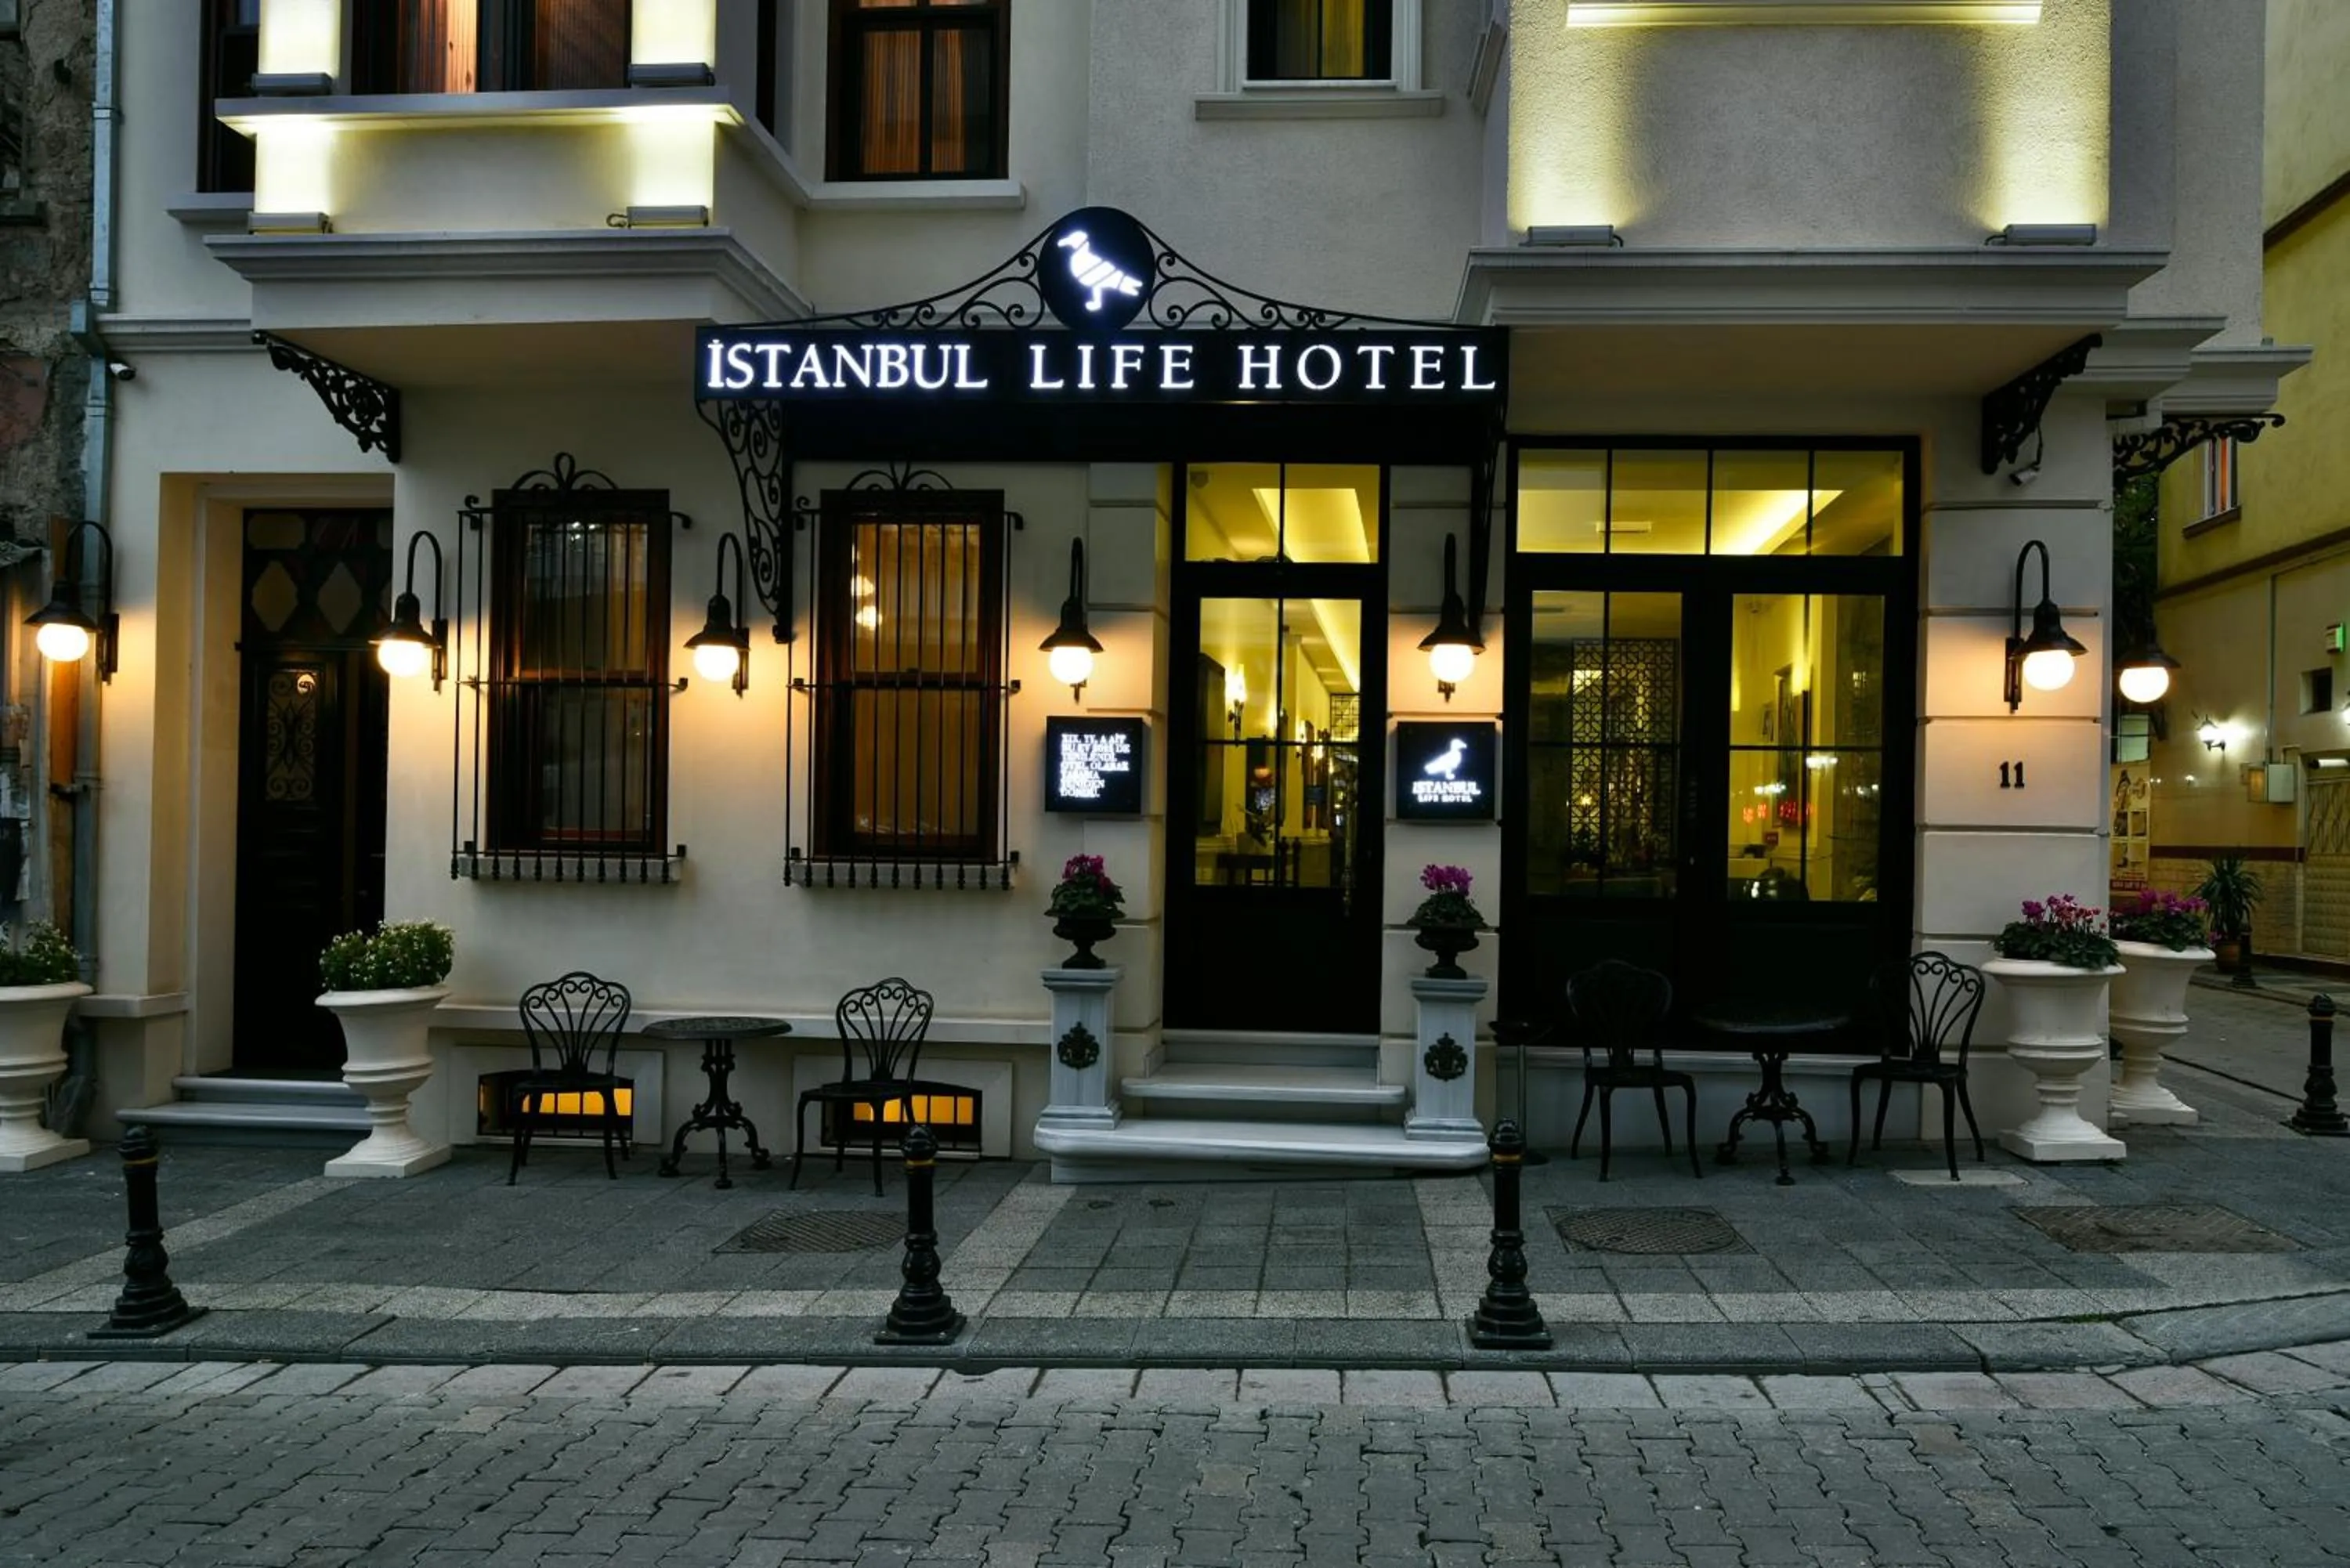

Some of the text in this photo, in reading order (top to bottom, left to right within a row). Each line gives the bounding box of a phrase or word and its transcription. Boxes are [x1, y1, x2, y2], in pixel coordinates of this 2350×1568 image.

[707, 338, 1496, 390] İSTANBUL LIFE HOTEL
[1999, 761, 2025, 789] 11
